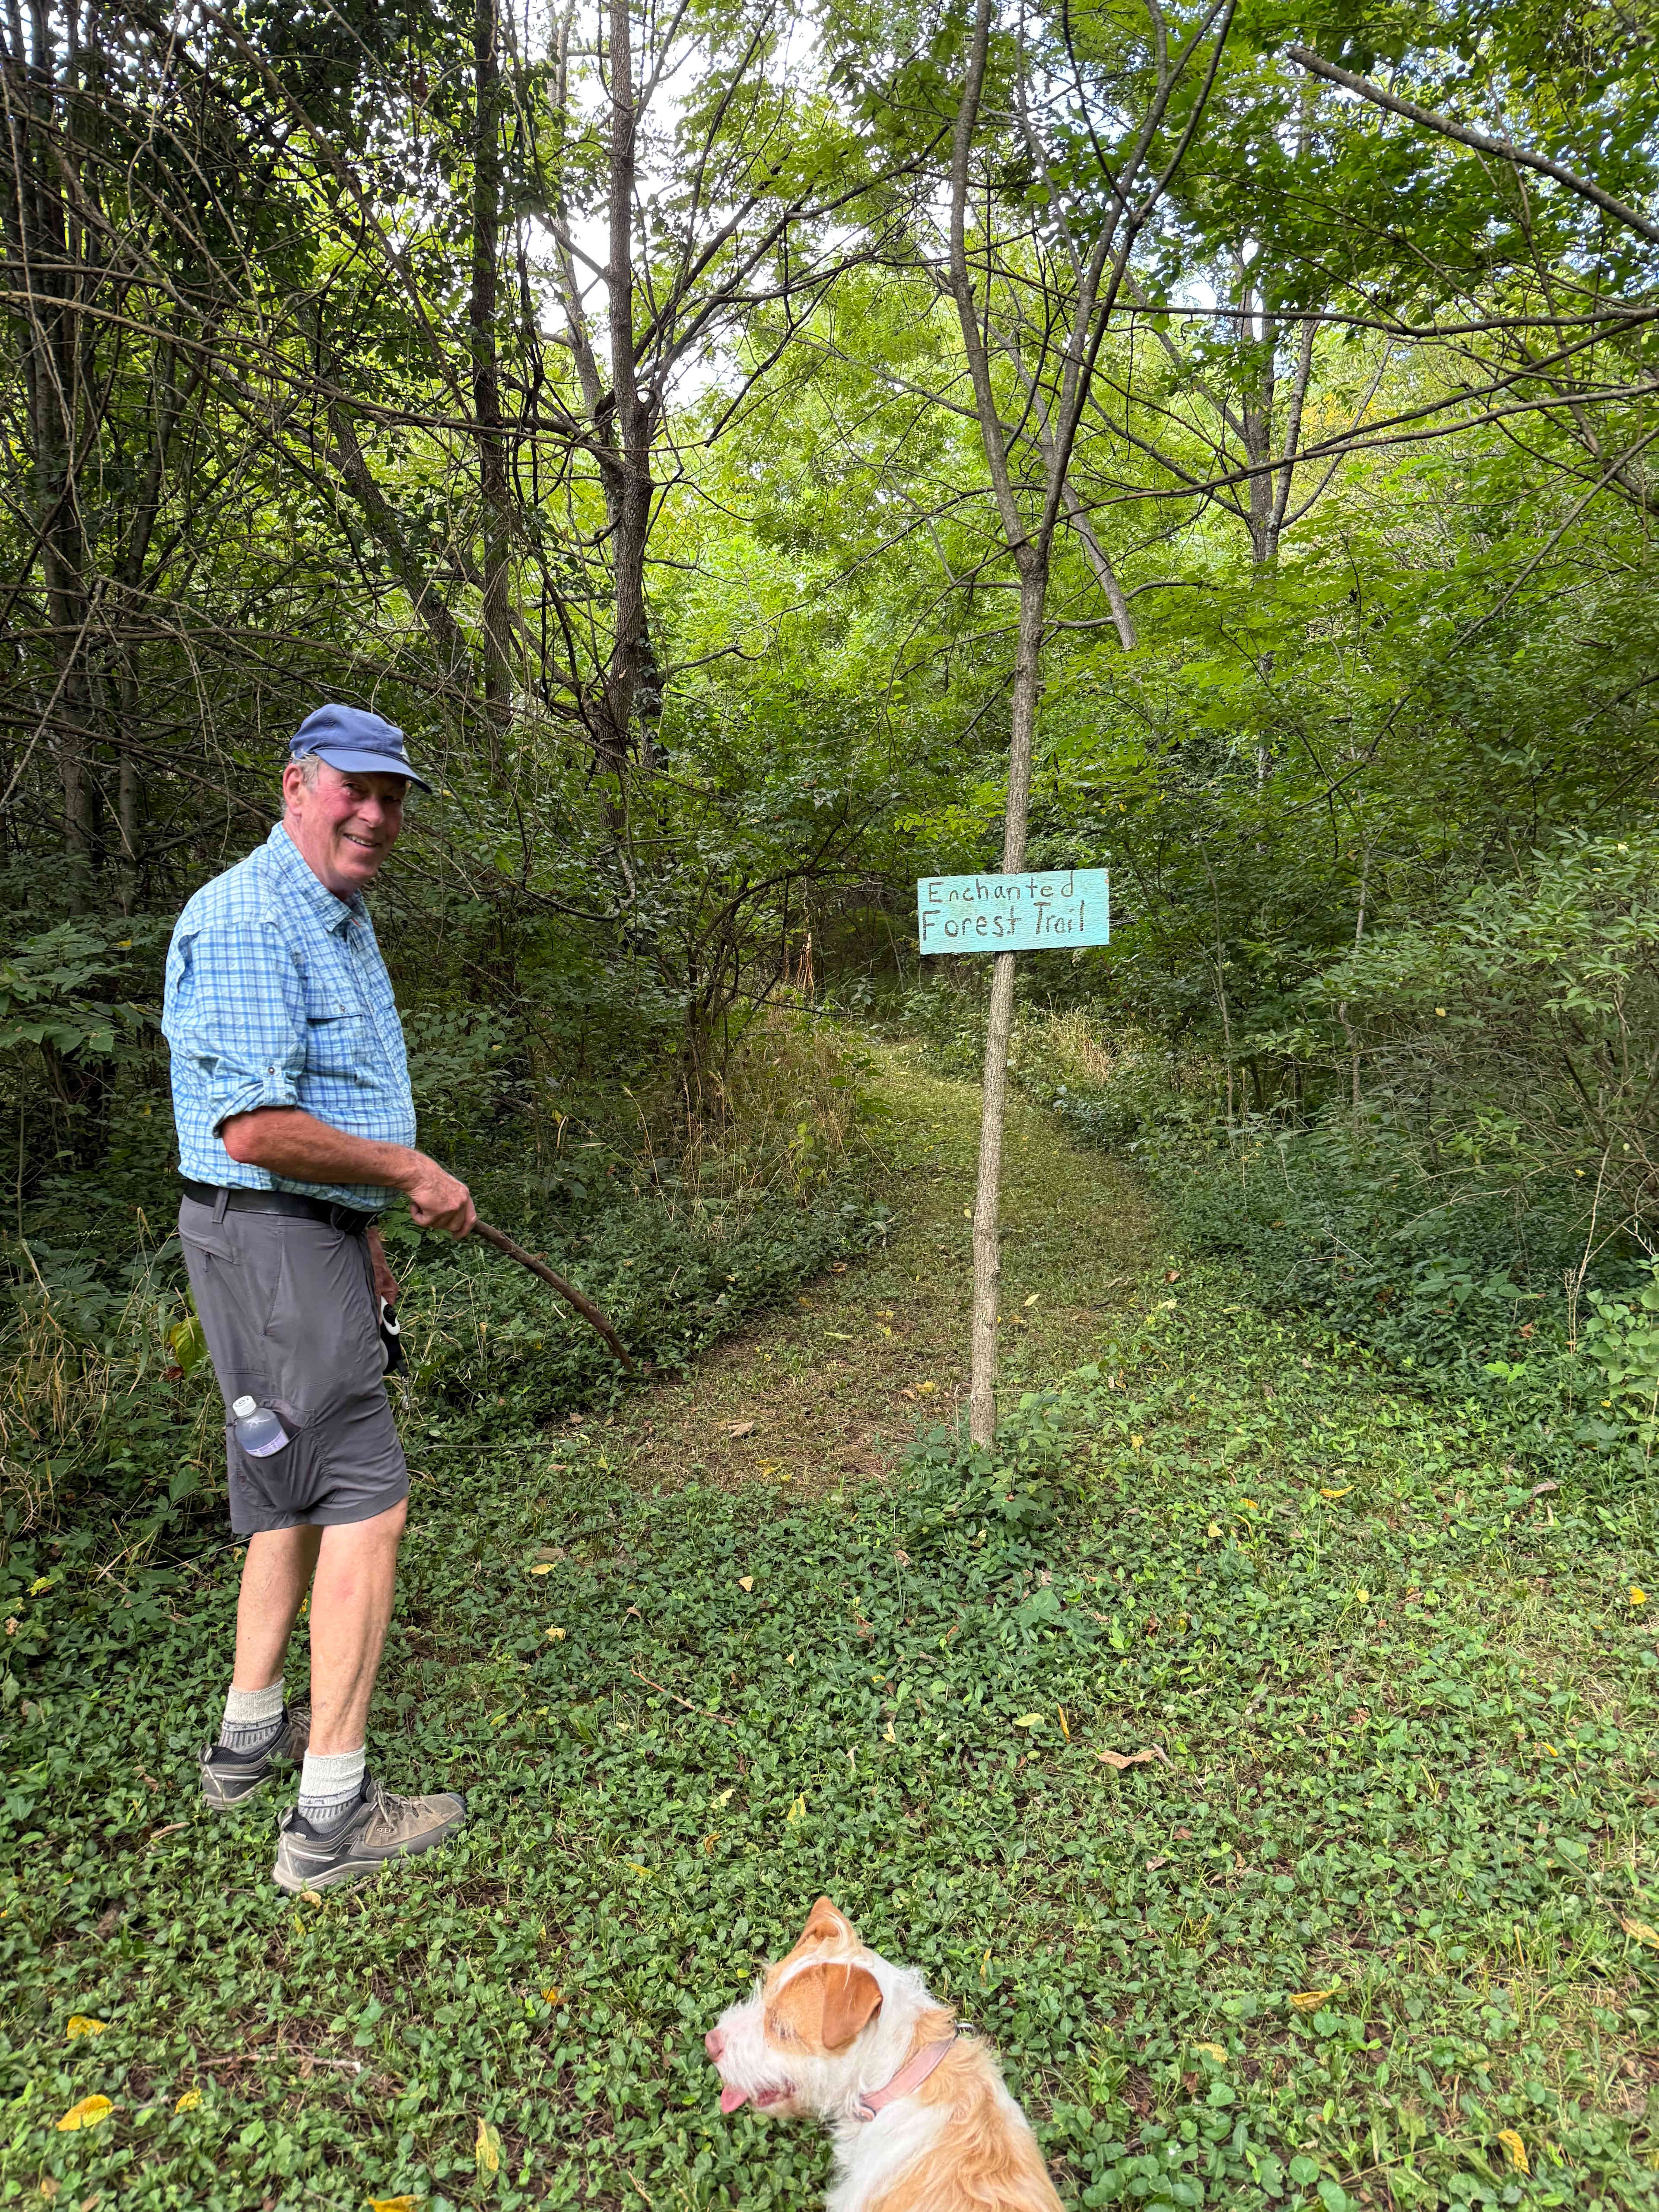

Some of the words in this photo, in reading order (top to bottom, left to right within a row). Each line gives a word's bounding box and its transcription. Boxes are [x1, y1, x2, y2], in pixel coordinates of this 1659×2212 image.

[928, 870, 1074, 903] Enchanted
[922, 906, 1022, 941] Forest
[1033, 899, 1084, 934] Trail
